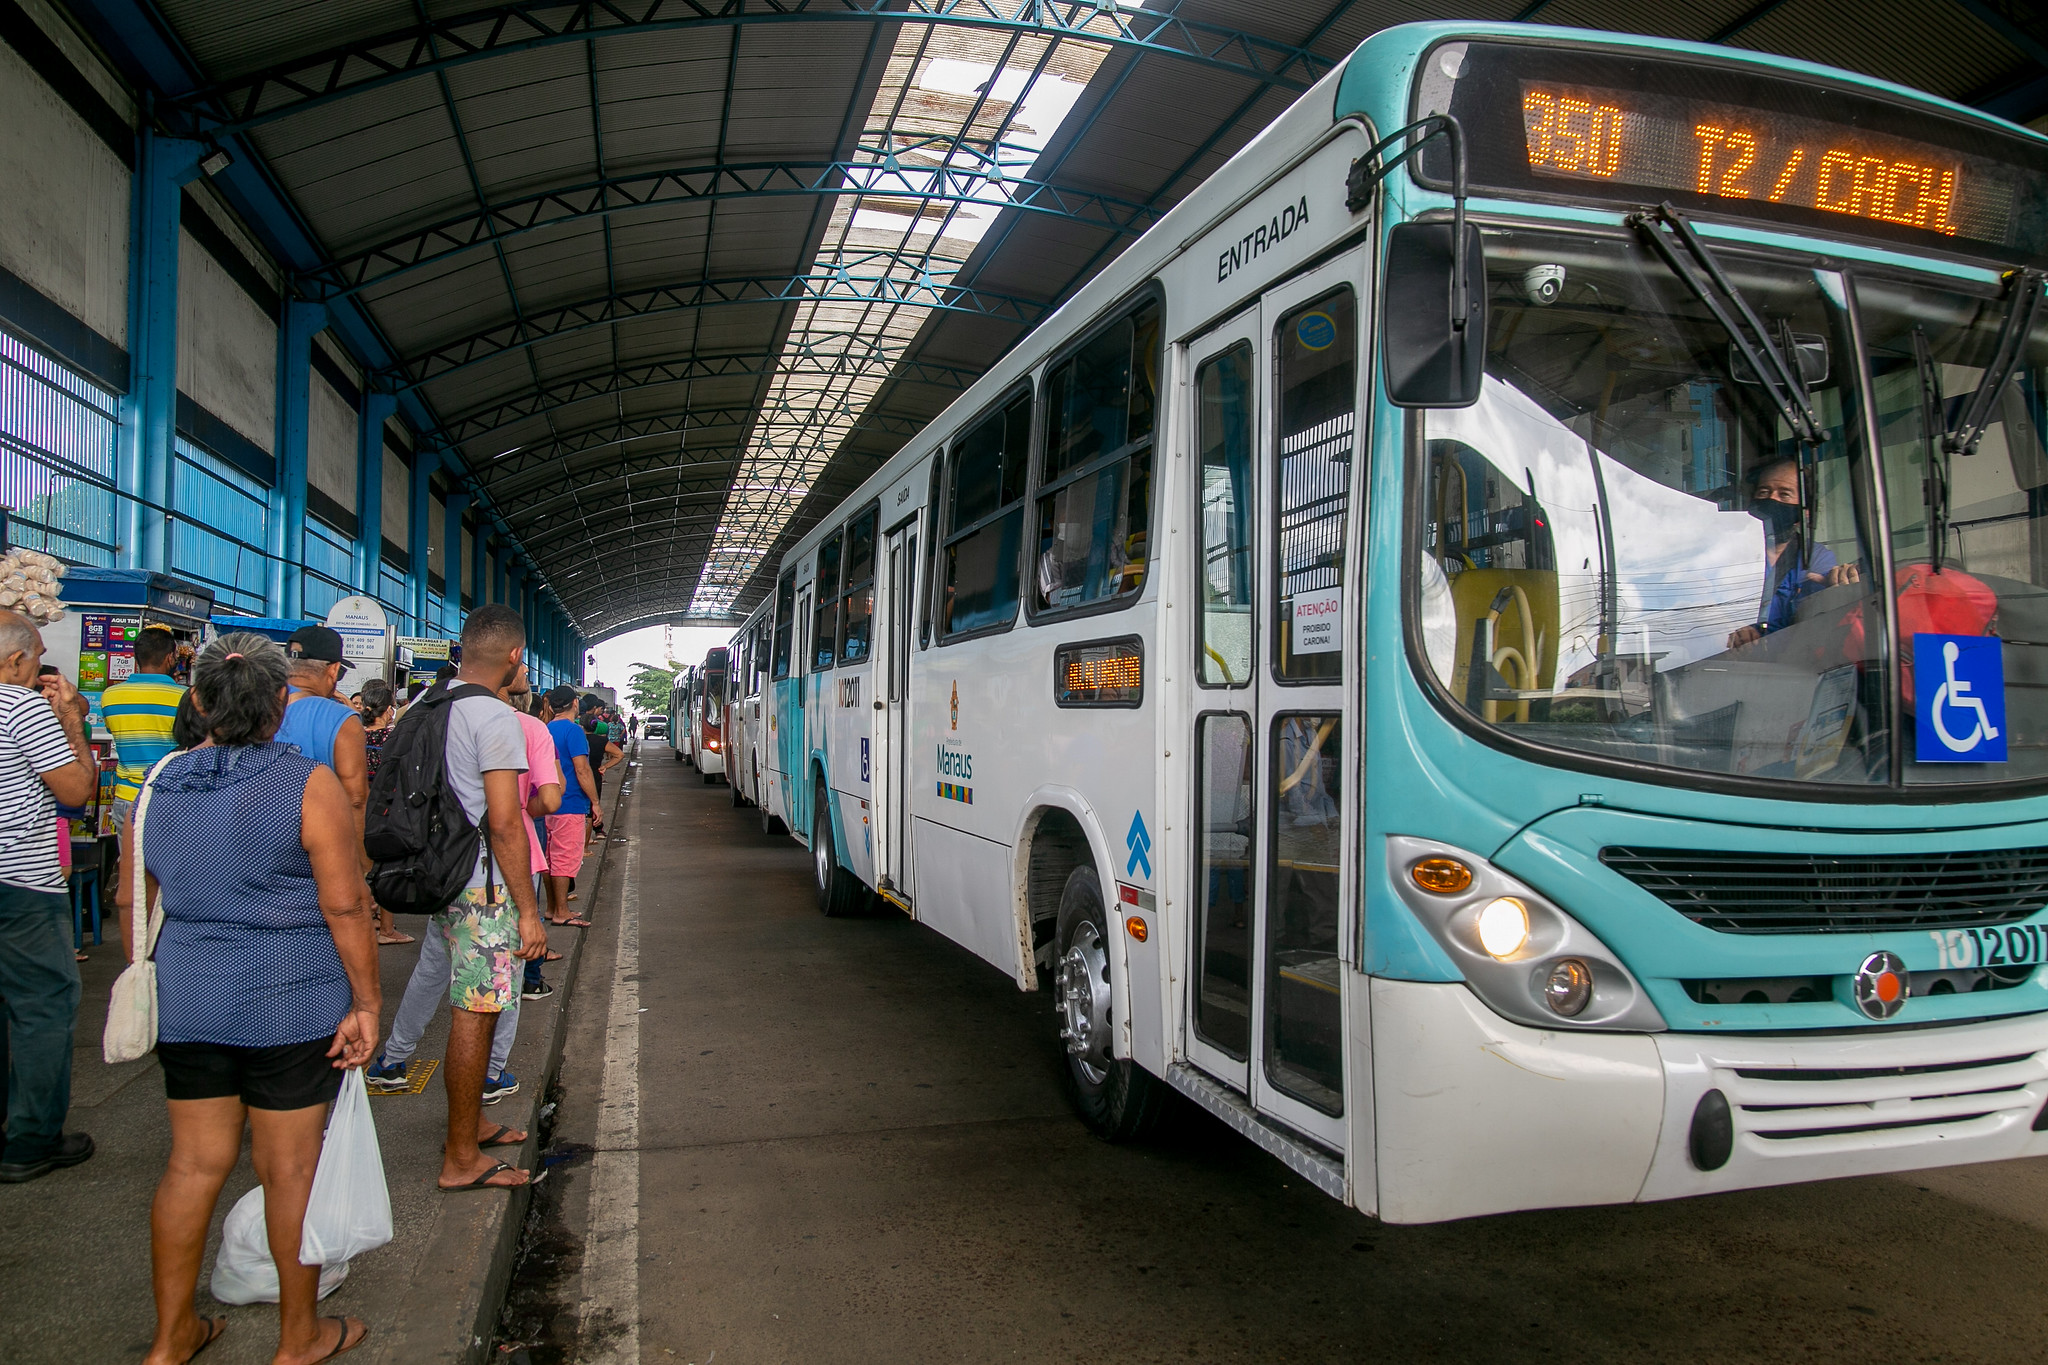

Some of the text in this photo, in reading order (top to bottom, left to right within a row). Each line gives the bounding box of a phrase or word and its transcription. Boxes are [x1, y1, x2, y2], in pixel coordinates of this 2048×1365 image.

[1524, 91, 1623, 177] 350
[1696, 124, 1756, 199] T2
[1217, 195, 1310, 284] ENTRADA
[1296, 598, 1338, 618] ATENÇÃO
[1302, 622, 1332, 634] PROIBIDO
[1303, 636, 1331, 646] CARONA!
[838, 676, 860, 709] 1012011
[936, 743, 972, 780] Manaus
